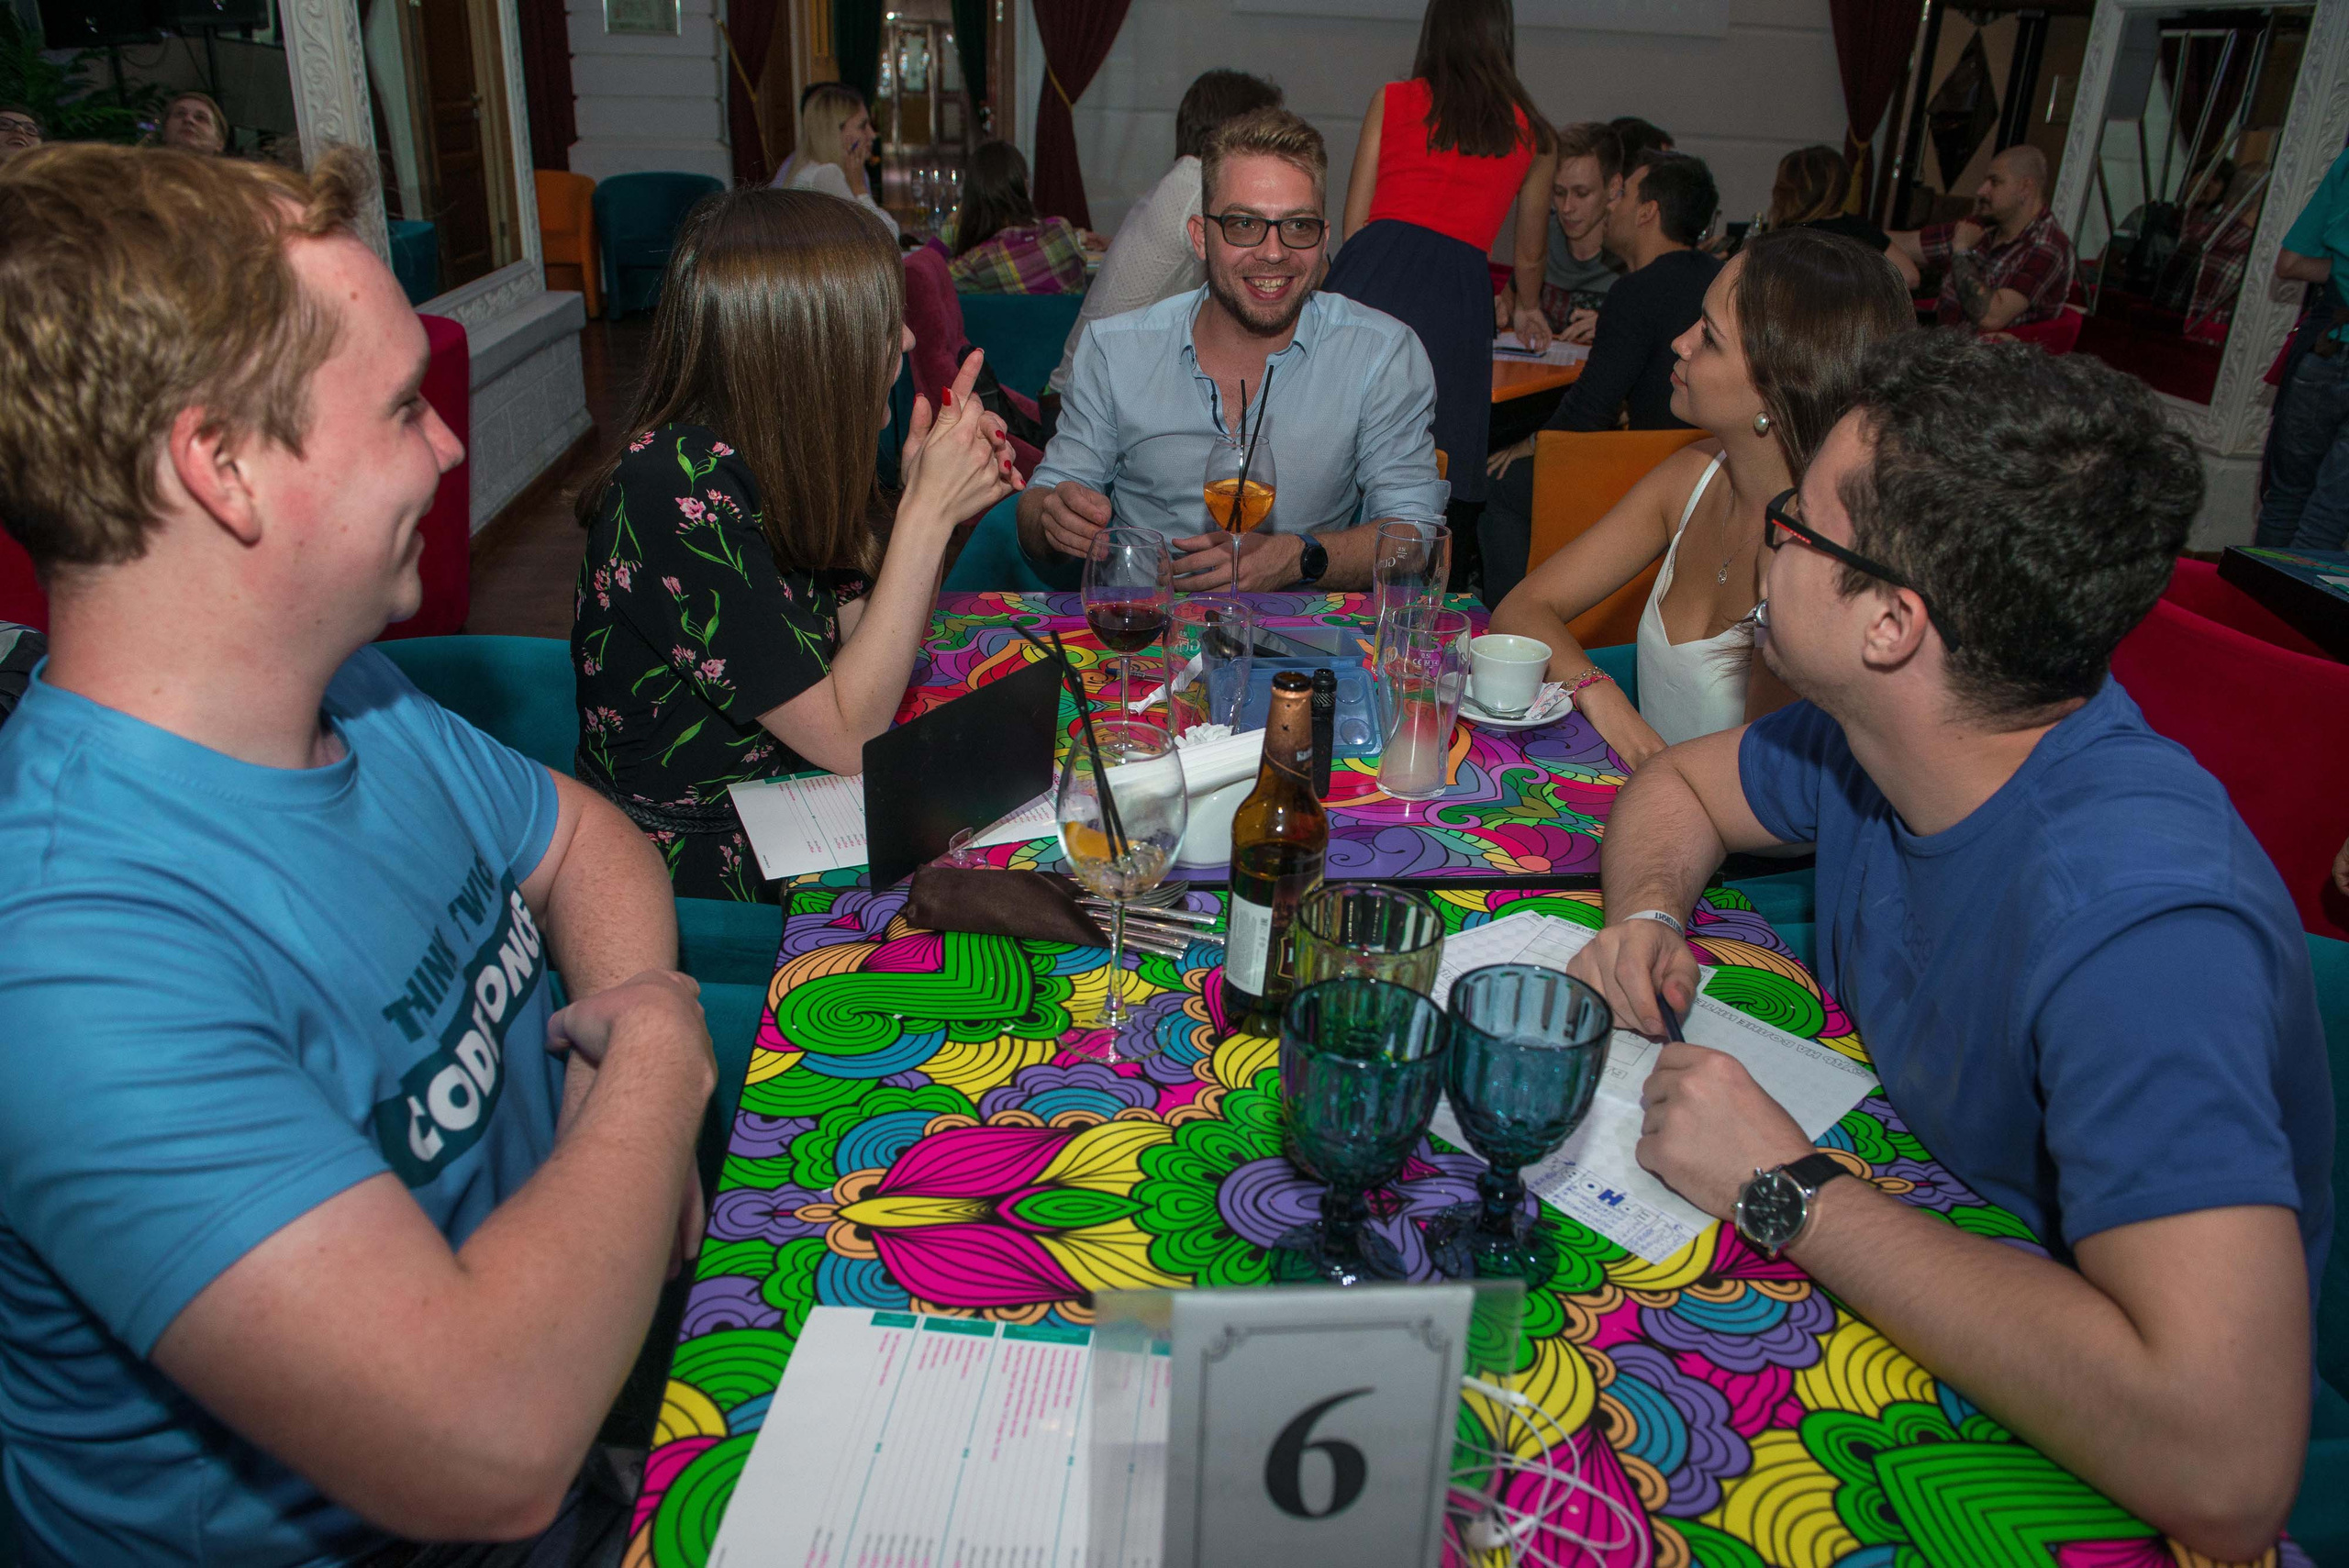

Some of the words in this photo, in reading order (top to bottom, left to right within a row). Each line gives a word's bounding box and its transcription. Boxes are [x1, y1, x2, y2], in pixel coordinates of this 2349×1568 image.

[382, 926, 457, 1043] THINK
[448, 846, 495, 942] TWIC
[1796, 1044, 1823, 1060] НА
[1264, 1385, 1375, 1520] 6
